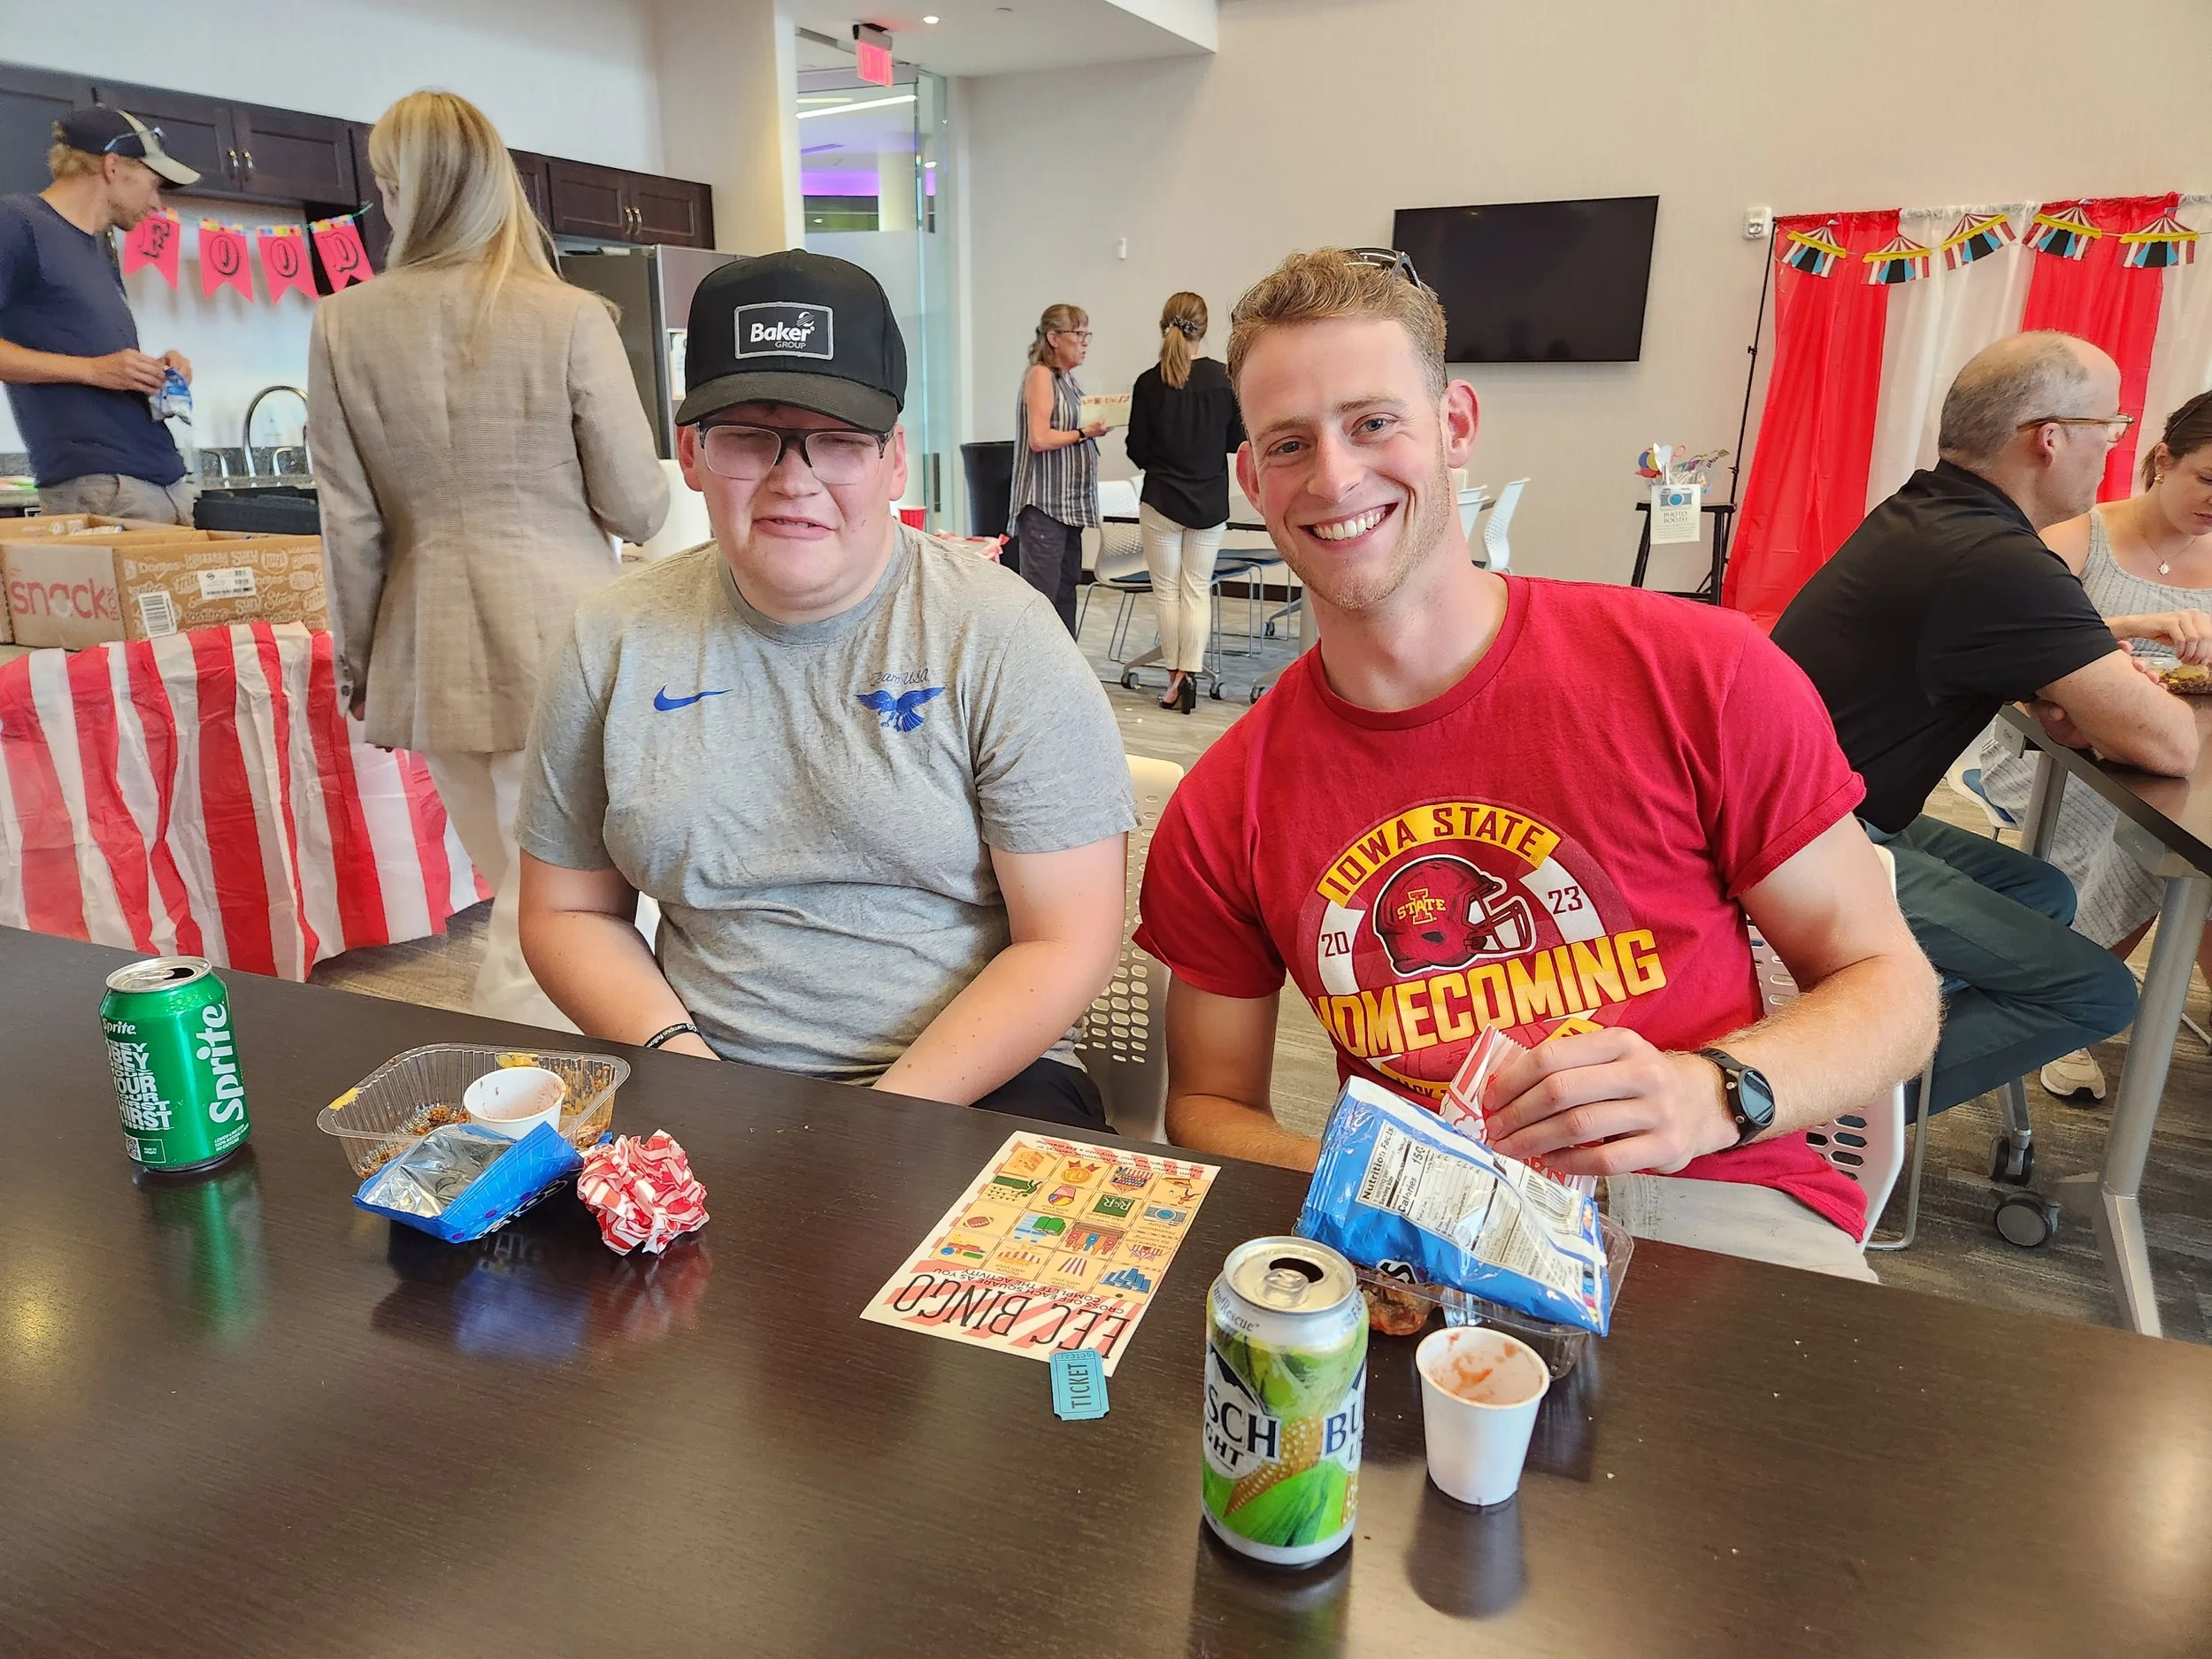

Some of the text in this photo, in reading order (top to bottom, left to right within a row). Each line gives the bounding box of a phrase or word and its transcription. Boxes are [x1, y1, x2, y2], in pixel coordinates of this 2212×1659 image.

[750, 321, 810, 342] Baker
[774, 341, 806, 349] GROUP
[10, 578, 110, 620] snack
[1326, 806, 1545, 895] IOWA STATE
[1397, 898, 1447, 920] STATE
[1548, 886, 1582, 914] 23
[1321, 931, 1349, 957] 20
[1310, 929, 1667, 1058] HOMECOMING
[103, 1018, 136, 1034] Sprite
[107, 1046, 150, 1070] BEY
[195, 1002, 245, 1124] Sprite
[114, 1076, 157, 1095] OUR
[119, 1106, 173, 1128] HIRST
[1361, 1148, 1386, 1200] Nutrition
[1379, 1125, 1395, 1149] Facts
[1099, 1196, 1133, 1210] R&R
[1396, 1175, 1417, 1212] Calories
[932, 1267, 1125, 1314] CROSS OFF EACH SQUARE AS YOU
[960, 1267, 1102, 1303] COMPLETE THE ACTIVITY
[893, 1272, 1131, 1360] EEC BINGO
[1068, 1363, 1092, 1409] TICKET
